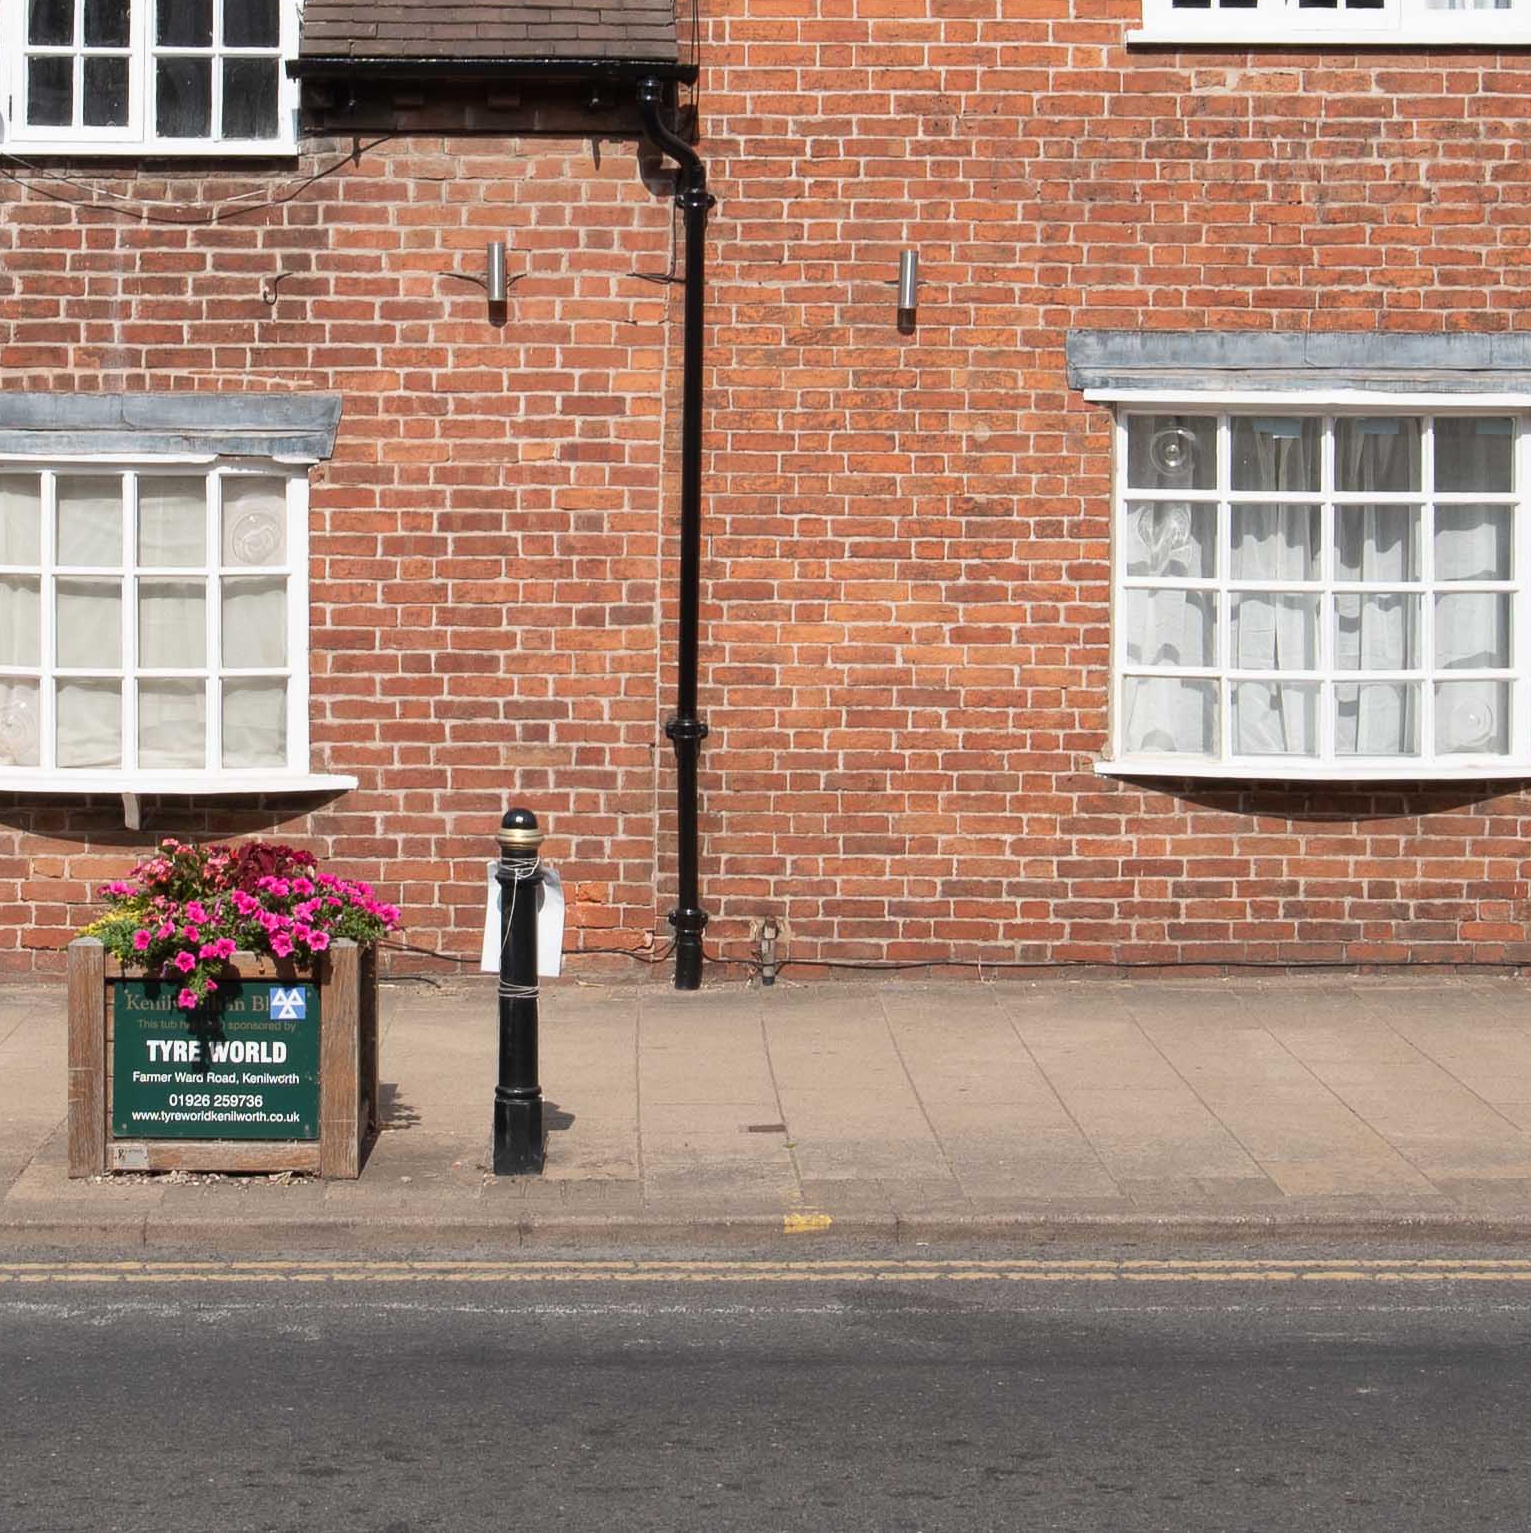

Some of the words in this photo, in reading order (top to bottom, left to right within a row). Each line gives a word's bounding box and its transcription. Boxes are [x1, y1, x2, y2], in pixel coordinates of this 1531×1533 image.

[139, 1019, 158, 1030] This
[160, 1020, 177, 1030] tub
[228, 1021, 281, 1033] sponsored
[284, 1021, 297, 1033] by
[146, 1040, 201, 1063] TYRE
[208, 1040, 287, 1064] WORLD
[132, 1071, 171, 1083] Farmer
[174, 1072, 204, 1084] Ward
[206, 1072, 240, 1085] Road,
[242, 1073, 300, 1085] Kenilworth
[169, 1094, 210, 1107] 01926
[213, 1095, 264, 1108] 259736
[132, 1110, 300, 1123] www.tyreworldkenilworth.co.uk
